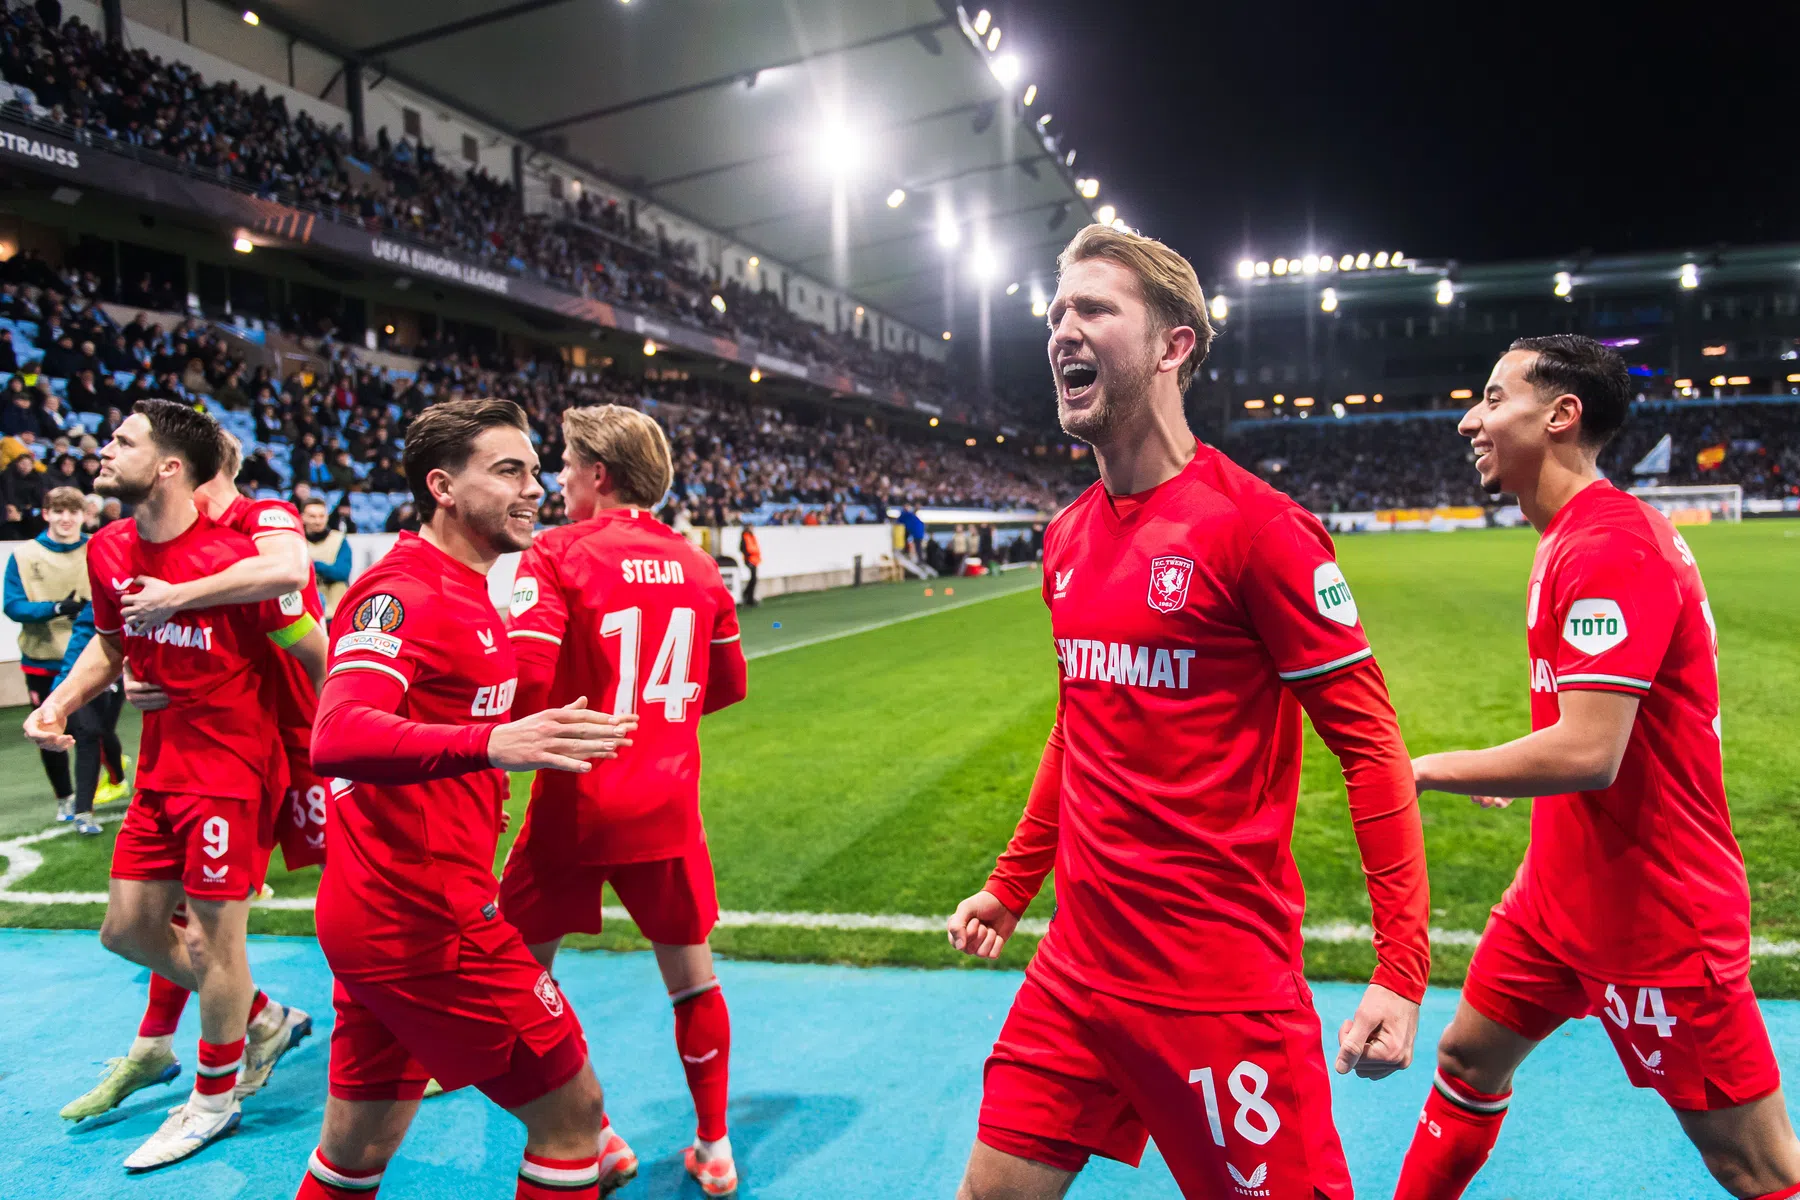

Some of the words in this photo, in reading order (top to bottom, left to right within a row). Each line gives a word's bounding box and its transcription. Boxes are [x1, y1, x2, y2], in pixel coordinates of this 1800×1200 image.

[372, 238, 410, 264] UEFA
[411, 249, 461, 279] EUROPA
[463, 264, 507, 294] LEAGUE
[621, 559, 685, 584] STEIJN
[1166, 560, 1191, 568] TWENTE
[1318, 582, 1351, 609] TOTO
[1570, 618, 1618, 636] TOTO
[600, 606, 701, 723] 14
[203, 816, 229, 859] 9
[1603, 983, 1677, 1037] 34
[1188, 1060, 1281, 1147] 18
[1234, 1186, 1271, 1197] CASTORE
